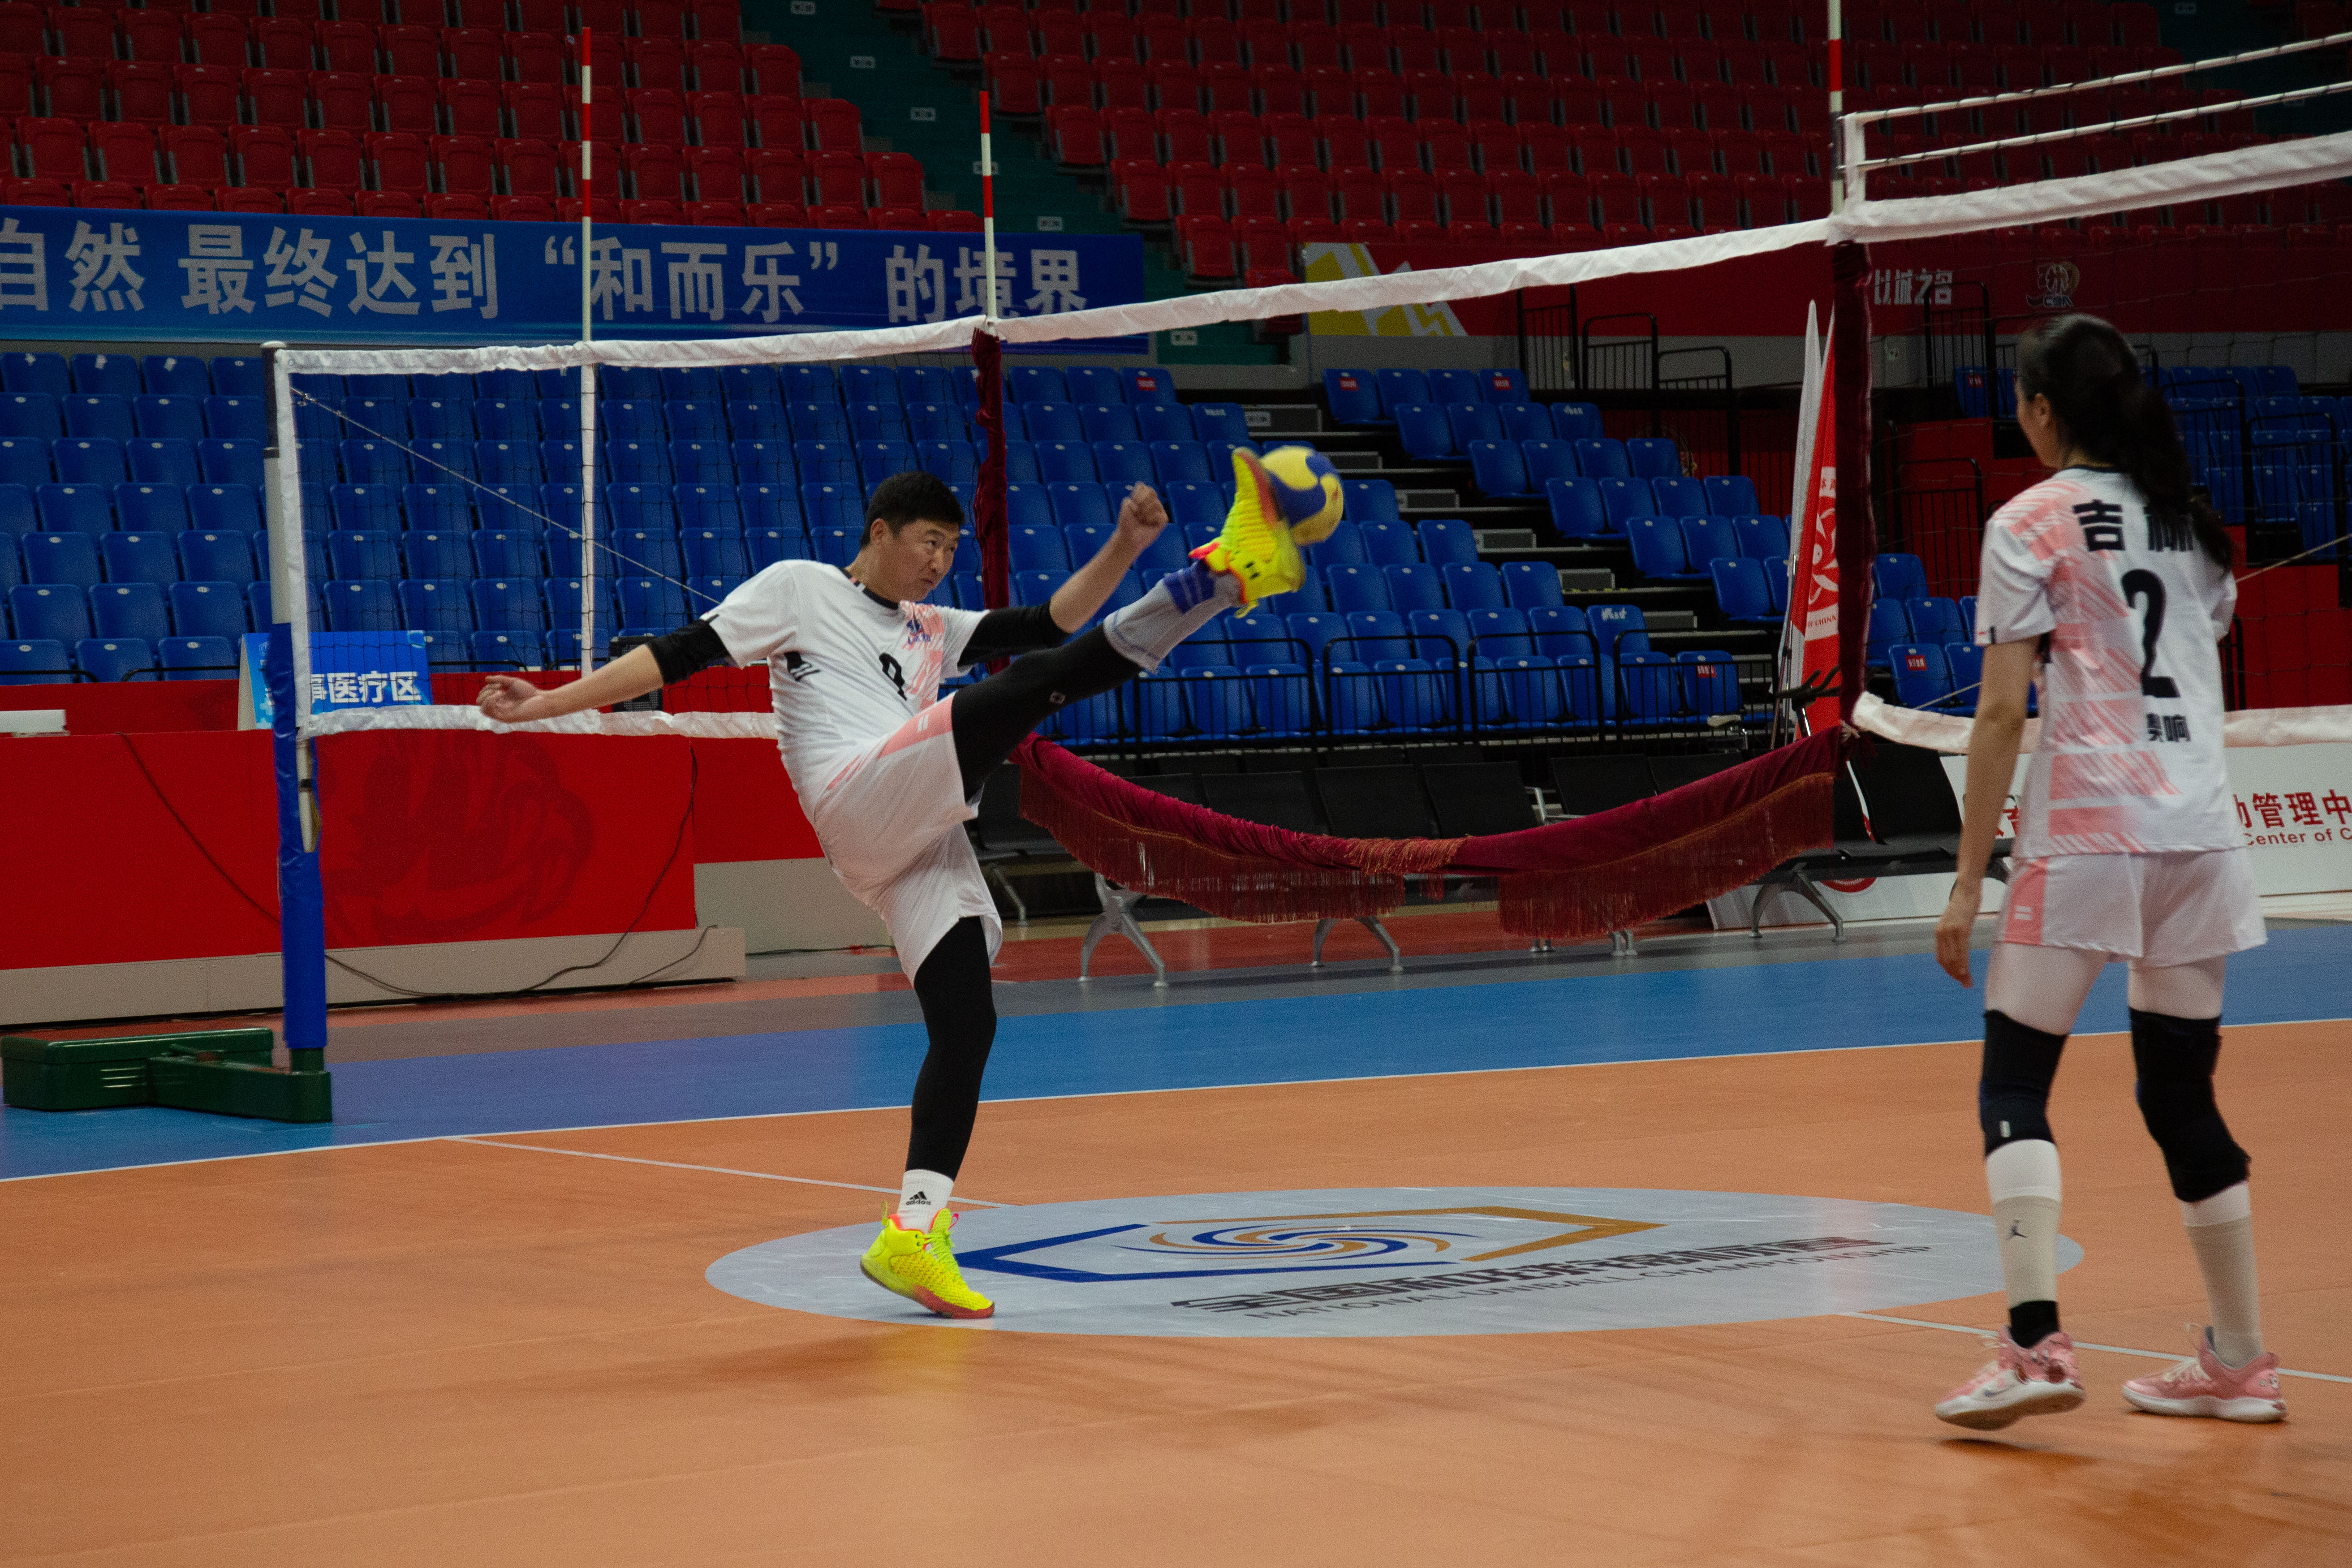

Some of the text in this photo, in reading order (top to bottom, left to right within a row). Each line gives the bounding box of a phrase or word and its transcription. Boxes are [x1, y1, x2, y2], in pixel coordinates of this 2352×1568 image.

[0, 217, 146, 313] 自然
[1815, 614, 1837, 626] CHINA
[2121, 568, 2180, 698] 2
[2314, 828, 2333, 842] of
[1245, 1245, 1931, 1319] NATIONAL UNIBALL CHAMPIONSHIP
